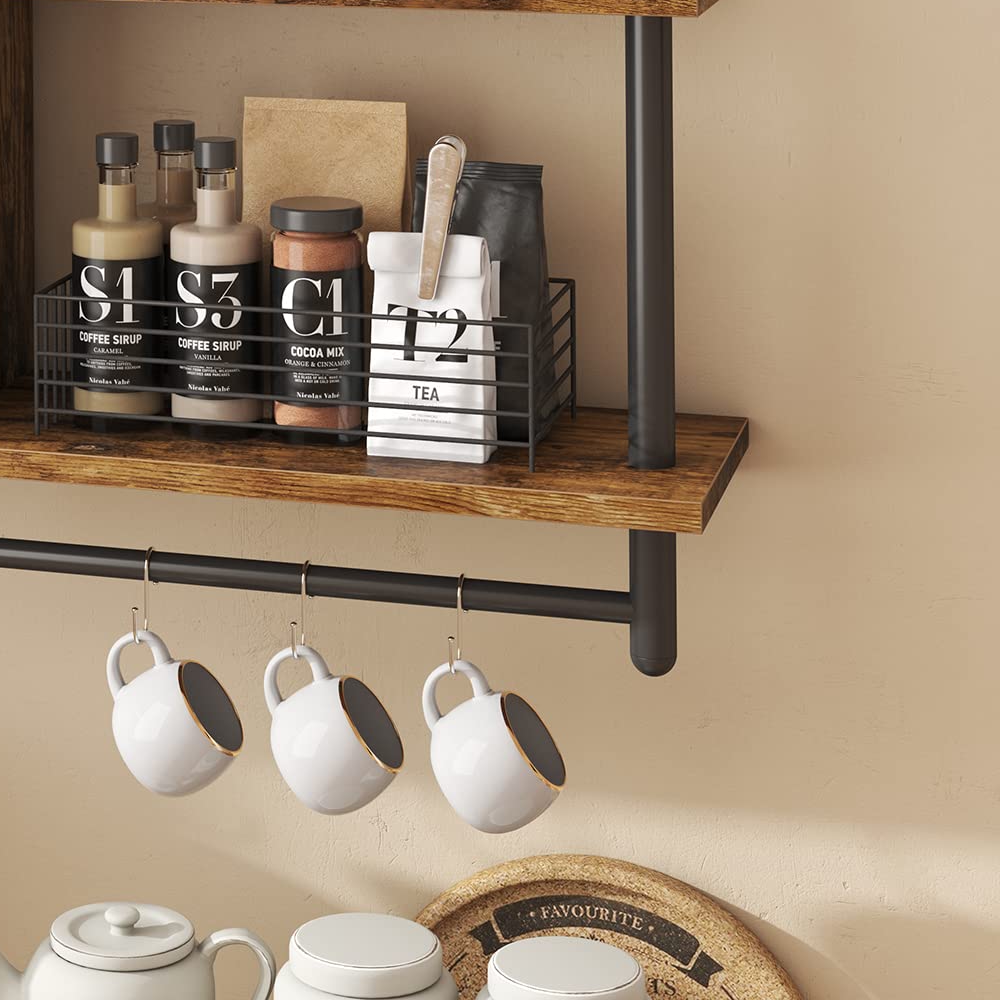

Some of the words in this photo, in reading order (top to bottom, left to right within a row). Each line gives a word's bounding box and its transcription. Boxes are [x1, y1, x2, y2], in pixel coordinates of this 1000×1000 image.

[79, 265, 140, 323] S1
[175, 270, 242, 329] S3
[281, 277, 349, 336] C1
[79, 331, 110, 345] COFFEE
[112, 334, 143, 345] SIRUP
[387, 303, 468, 363] T2
[93, 346, 124, 354] CARAMEL
[178, 337, 210, 351] COFFEE
[212, 340, 242, 351] SIRUP
[290, 346, 324, 358] COCOA
[326, 347, 345, 358] MIX
[284, 358, 310, 367] ORANGE
[316, 360, 351, 368] CINNAMON
[89, 377, 112, 385] Nicolas
[188, 384, 212, 392] Nicolas
[296, 391, 322, 399] Nicolas
[324, 391, 340, 399] Vahé
[412, 385, 440, 402] TEA
[539, 904, 643, 930] FAVOURITE
